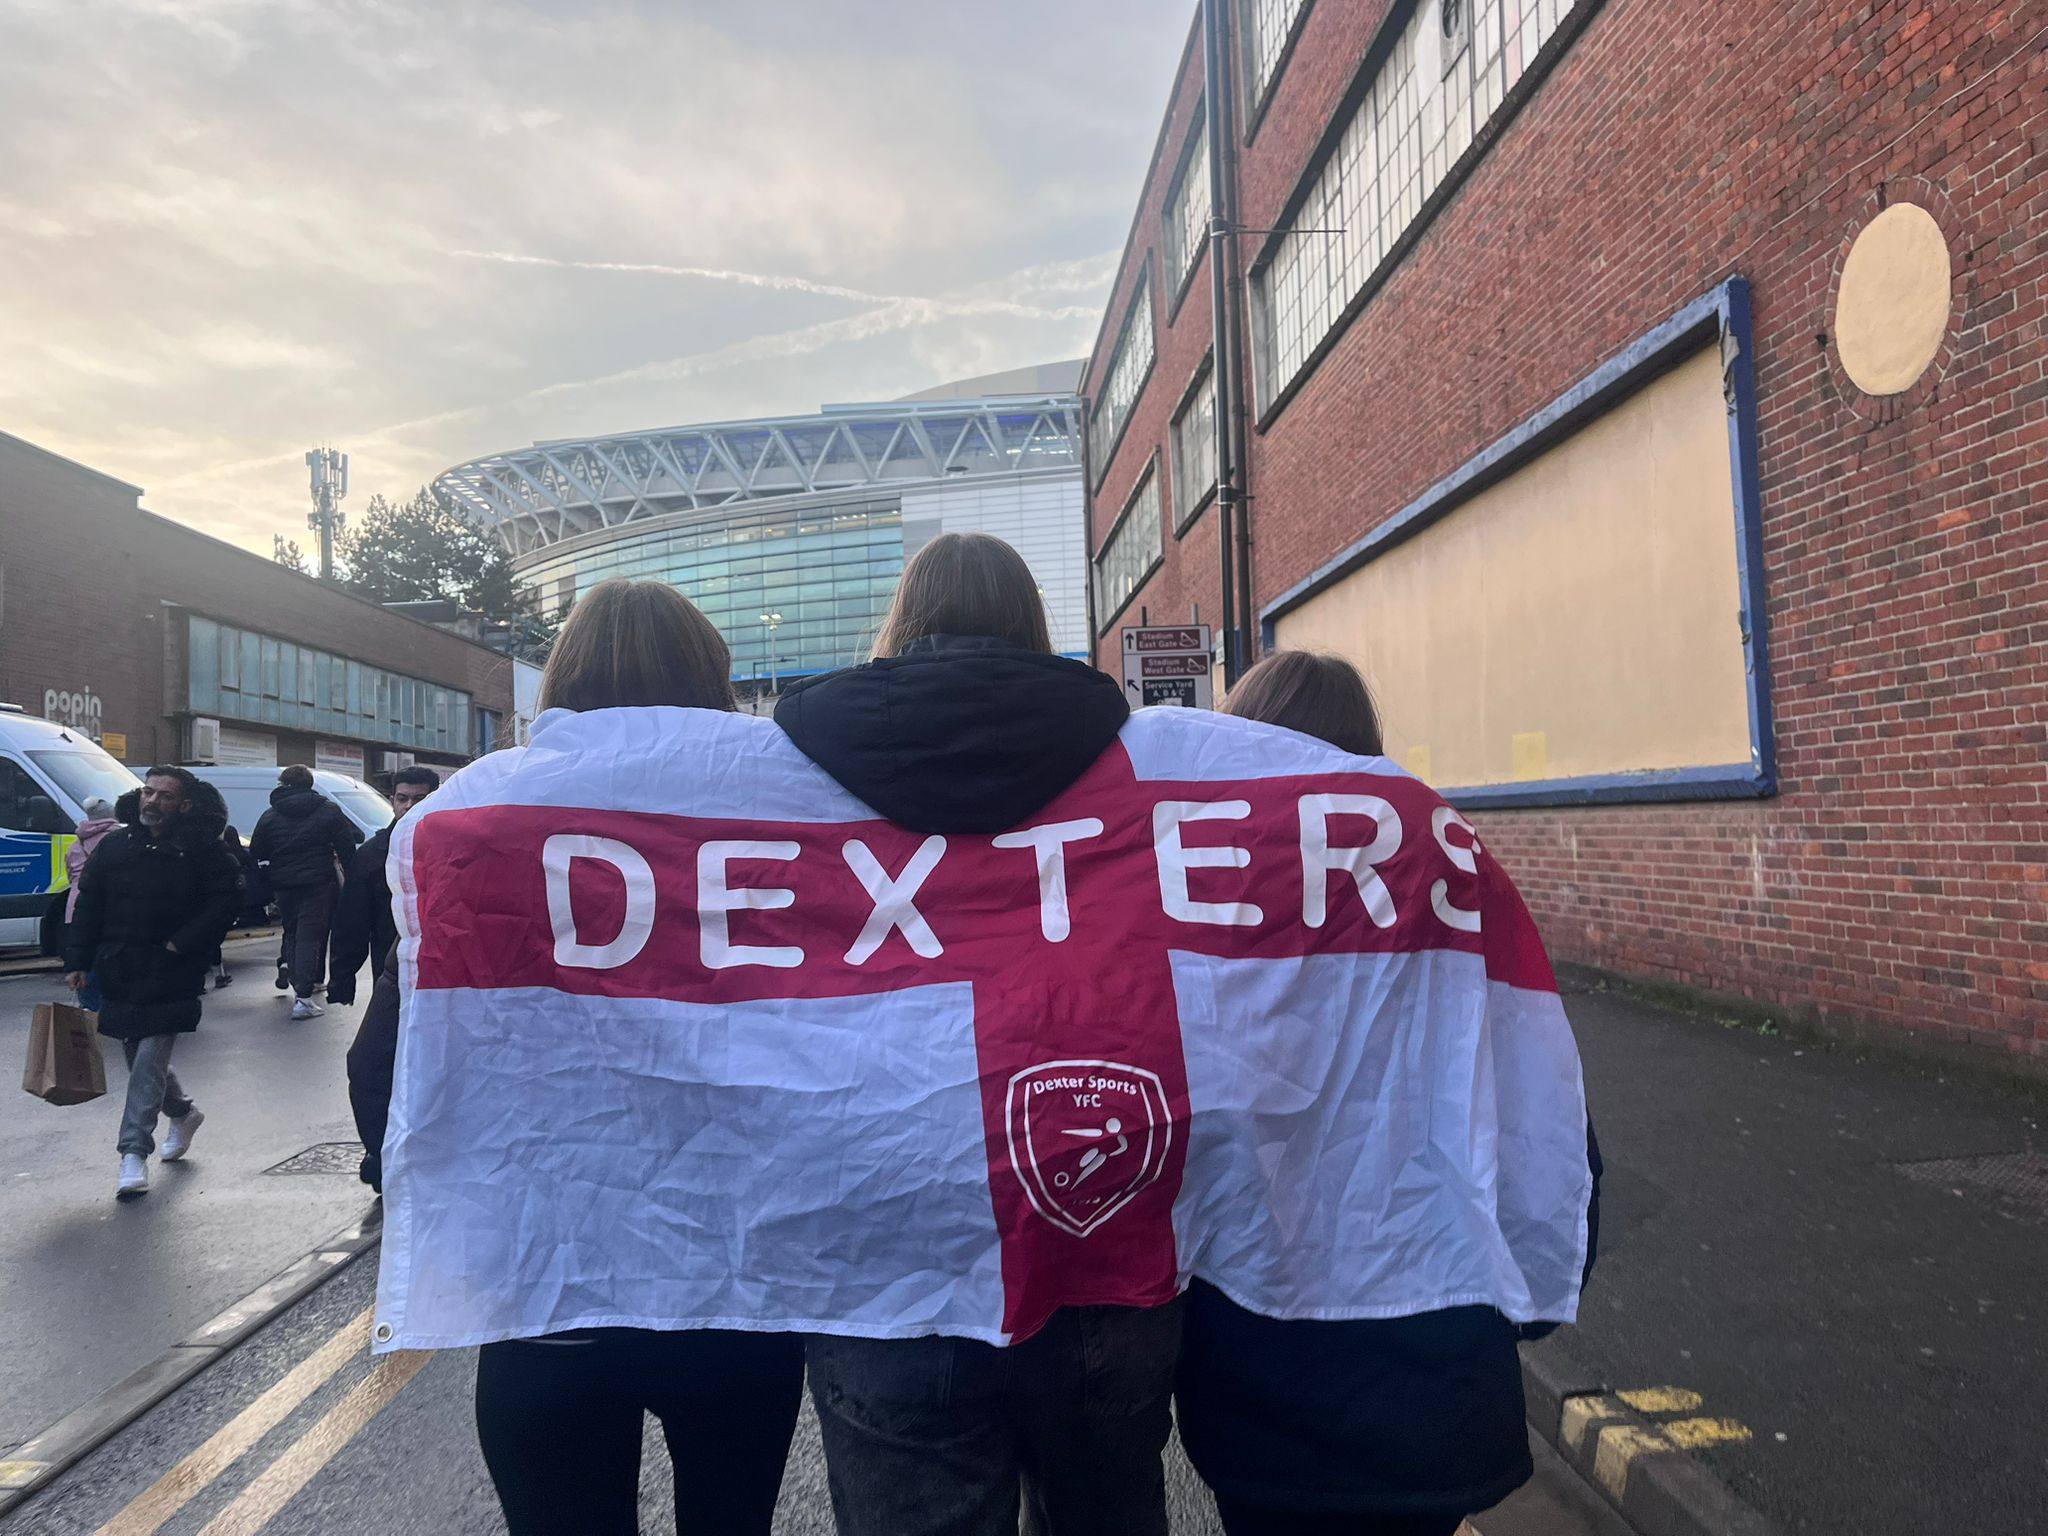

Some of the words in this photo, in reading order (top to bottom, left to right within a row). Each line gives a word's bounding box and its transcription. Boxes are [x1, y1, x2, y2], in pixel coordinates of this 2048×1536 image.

[1158, 640, 1177, 648] Gate
[1144, 666, 1164, 674] West
[1166, 665, 1185, 673] Gate
[44, 685, 102, 725] popin
[542, 793, 1482, 969] DEXTERS
[1033, 1077, 1084, 1095] Dexter
[1087, 1075, 1137, 1095] Sports
[1073, 1094, 1102, 1108] YFC
